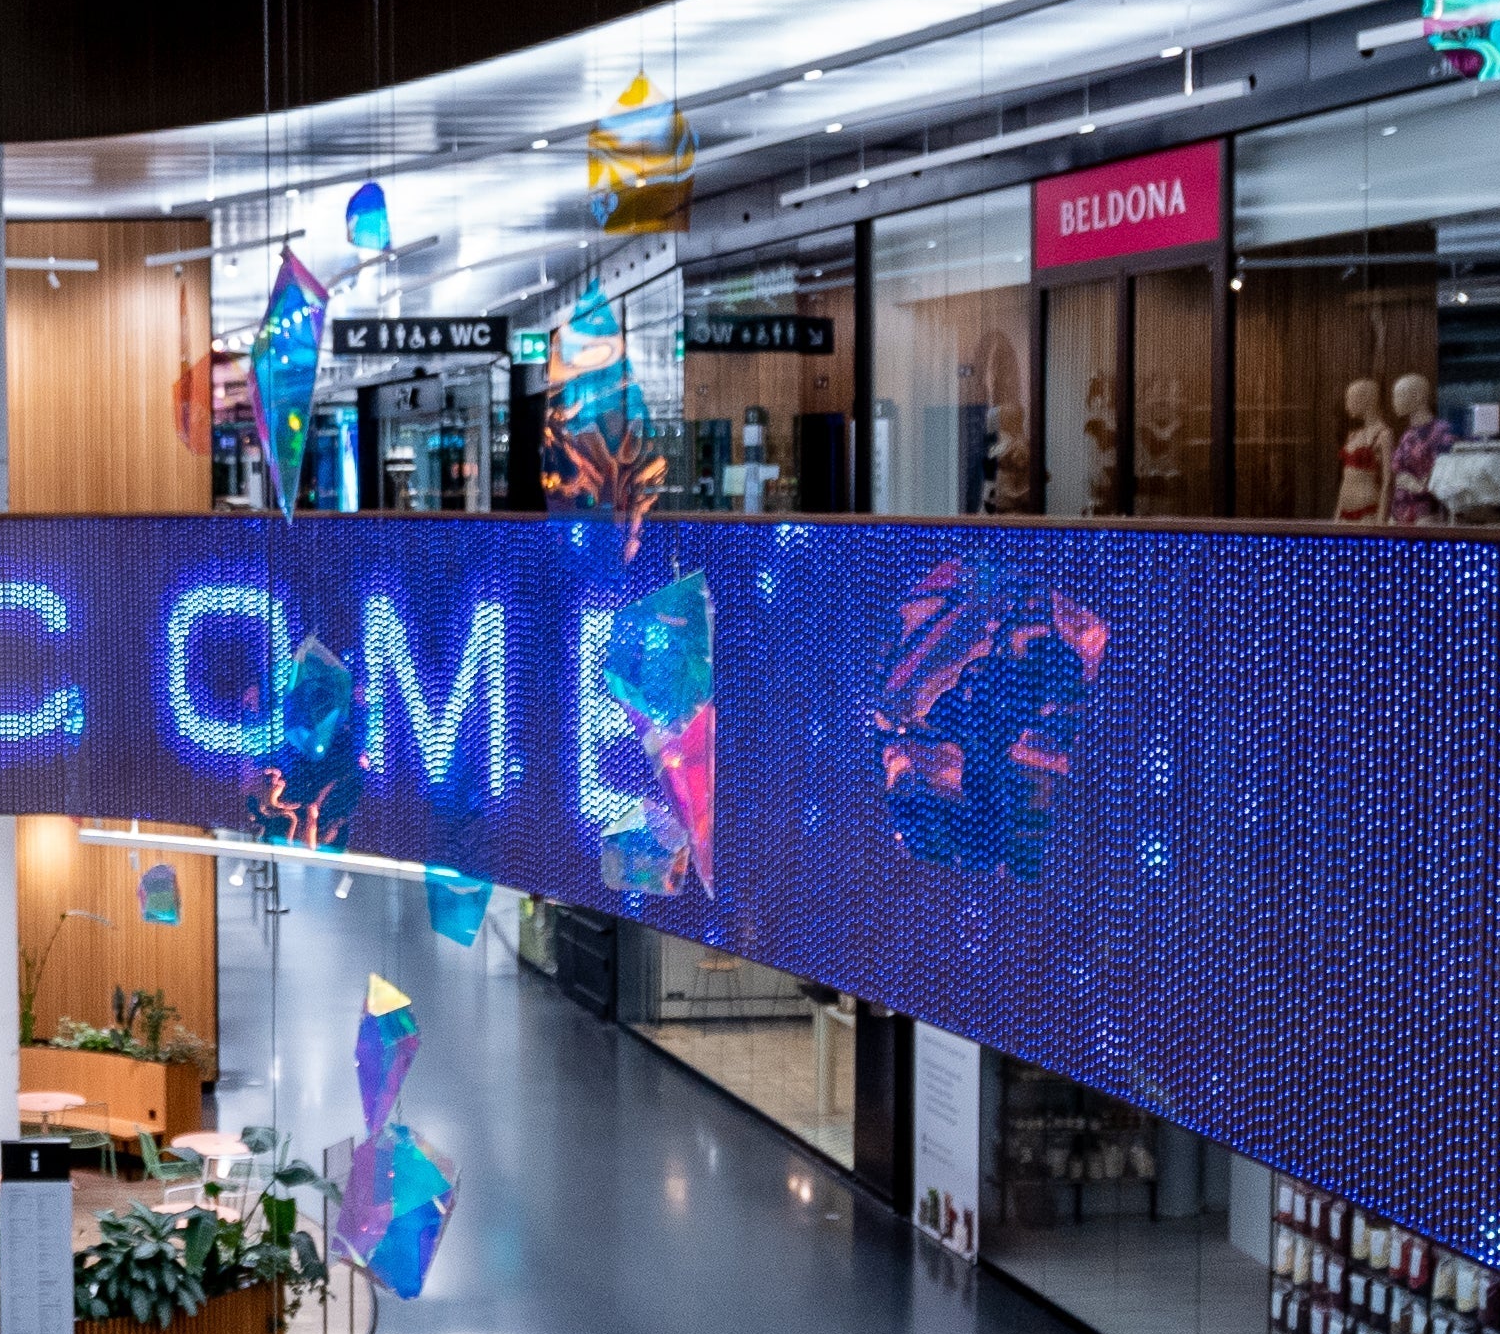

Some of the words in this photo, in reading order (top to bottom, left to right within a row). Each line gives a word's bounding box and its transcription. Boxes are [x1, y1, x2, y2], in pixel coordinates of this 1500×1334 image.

[1059, 176, 1187, 237] BELDONA
[448, 323, 492, 348] WC
[29, 1149, 42, 1173] i
